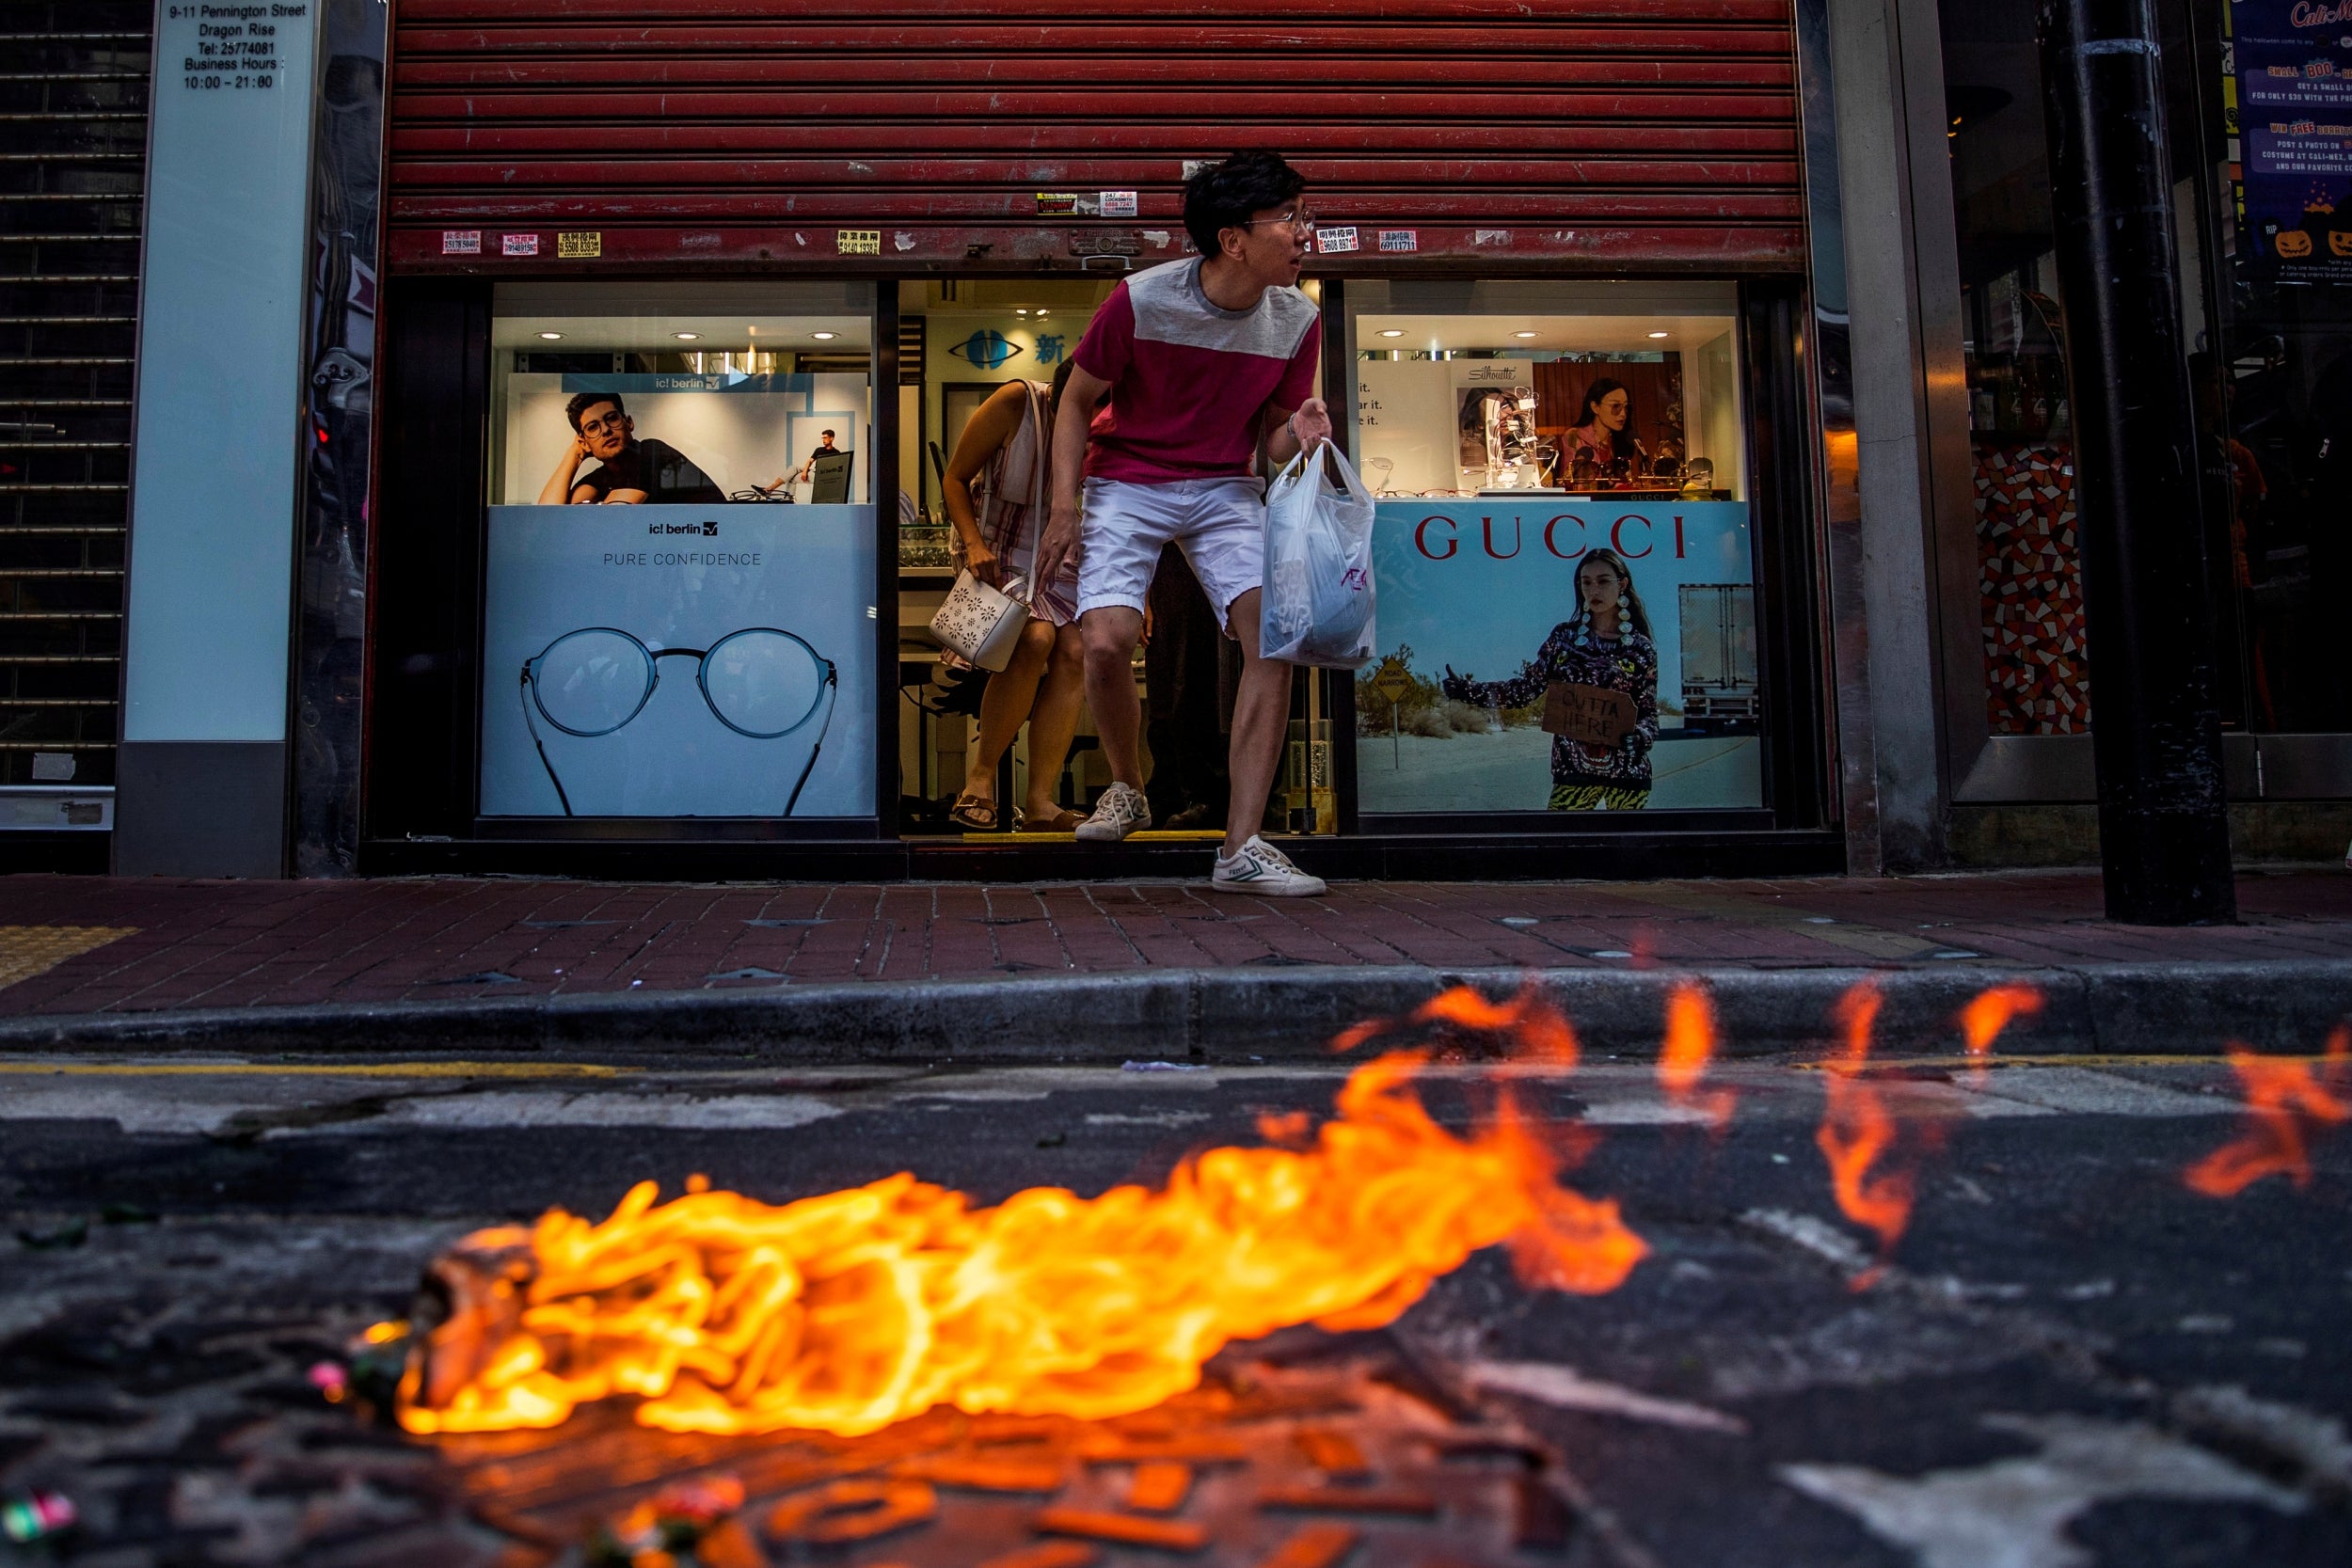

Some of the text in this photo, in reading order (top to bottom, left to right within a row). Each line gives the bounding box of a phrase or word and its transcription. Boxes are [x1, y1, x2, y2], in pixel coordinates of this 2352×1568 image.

[170, 4, 306, 19] 9-11 Pennington Street
[199, 23, 276, 39] Dragon Rise
[198, 42, 275, 55] Tel: 25774081
[184, 57, 238, 71] Business
[242, 57, 277, 70] Hours
[2267, 66, 2299, 77] SMALL
[2306, 61, 2333, 79] BOO
[184, 76, 221, 88] 10:00
[2267, 92, 2286, 101] ONLY
[2304, 93, 2324, 102] WITH
[2269, 122, 2288, 134] WIN
[2290, 121, 2314, 135] FREE
[2277, 140, 2296, 149] POST
[2307, 164, 2344, 172] FAVORITE
[2265, 225, 2277, 234] RIP
[844, 243, 857, 254] 9140
[1035, 333, 1066, 365] 新
[1468, 365, 1517, 381] Silhouette
[656, 377, 704, 388] ic! berlin
[1359, 382, 1371, 393] it.
[1371, 400, 1383, 410] it.
[1367, 416, 1379, 426] it.
[1630, 493, 1665, 501] GUCCI
[649, 523, 701, 534] ic! berlin
[1413, 514, 1687, 561] GUCCI
[603, 553, 761, 565] PURE CONFIDENCE
[1563, 690, 1619, 718] OUTTA
[1563, 710, 1613, 738] HERE
